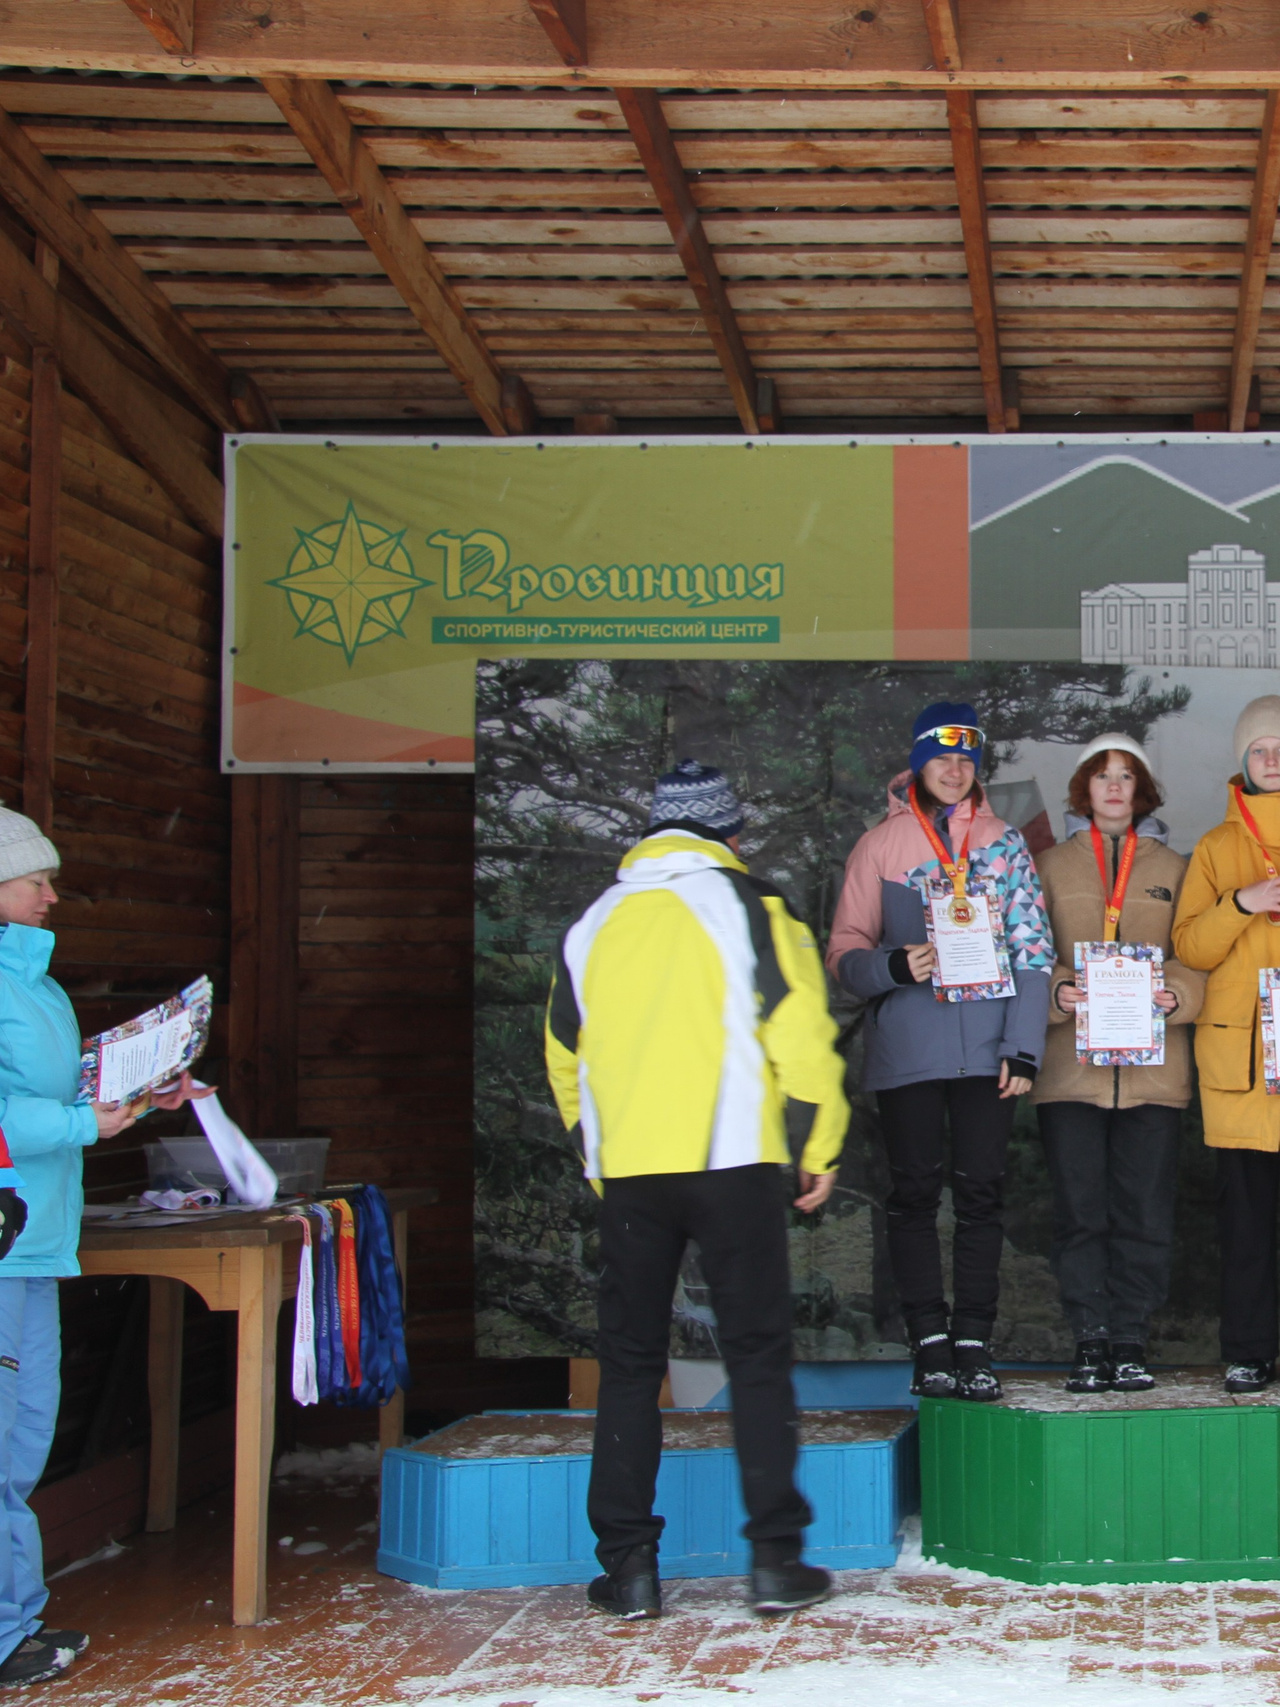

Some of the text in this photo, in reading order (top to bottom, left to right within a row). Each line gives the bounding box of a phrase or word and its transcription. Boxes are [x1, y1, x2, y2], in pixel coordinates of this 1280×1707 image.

[426, 529, 784, 614] Провинция
[443, 621, 768, 639] СПОРТИВНО-ТУРИСТИЧЕСКИЙ ЦЕНТР
[1094, 970, 1144, 979] ГРАМОТА
